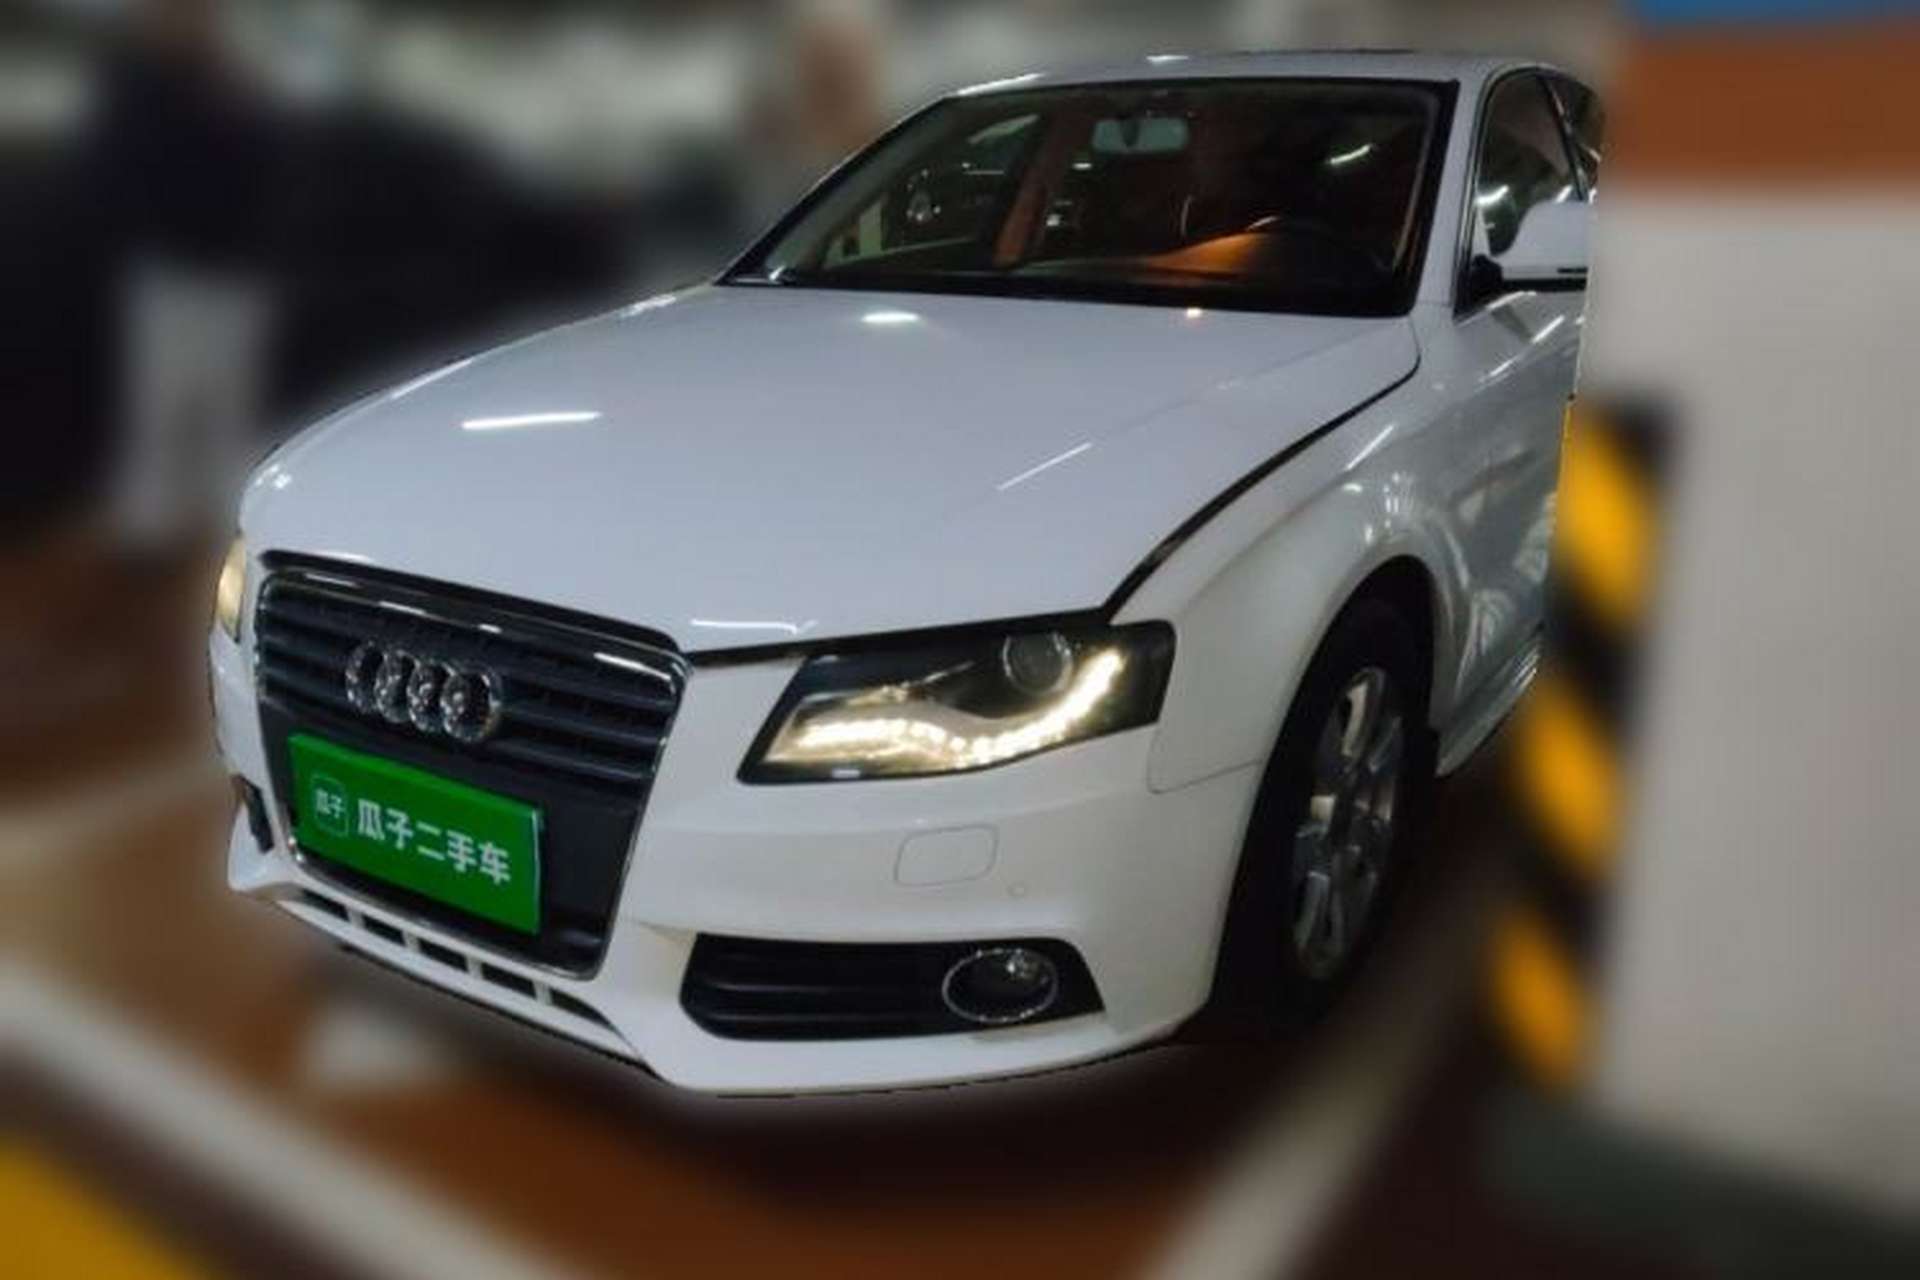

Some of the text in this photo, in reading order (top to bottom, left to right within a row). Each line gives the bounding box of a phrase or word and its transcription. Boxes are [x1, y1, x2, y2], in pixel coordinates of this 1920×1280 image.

[315, 788, 345, 819] 瓜子
[357, 798, 512, 886] 瓜子二手车
